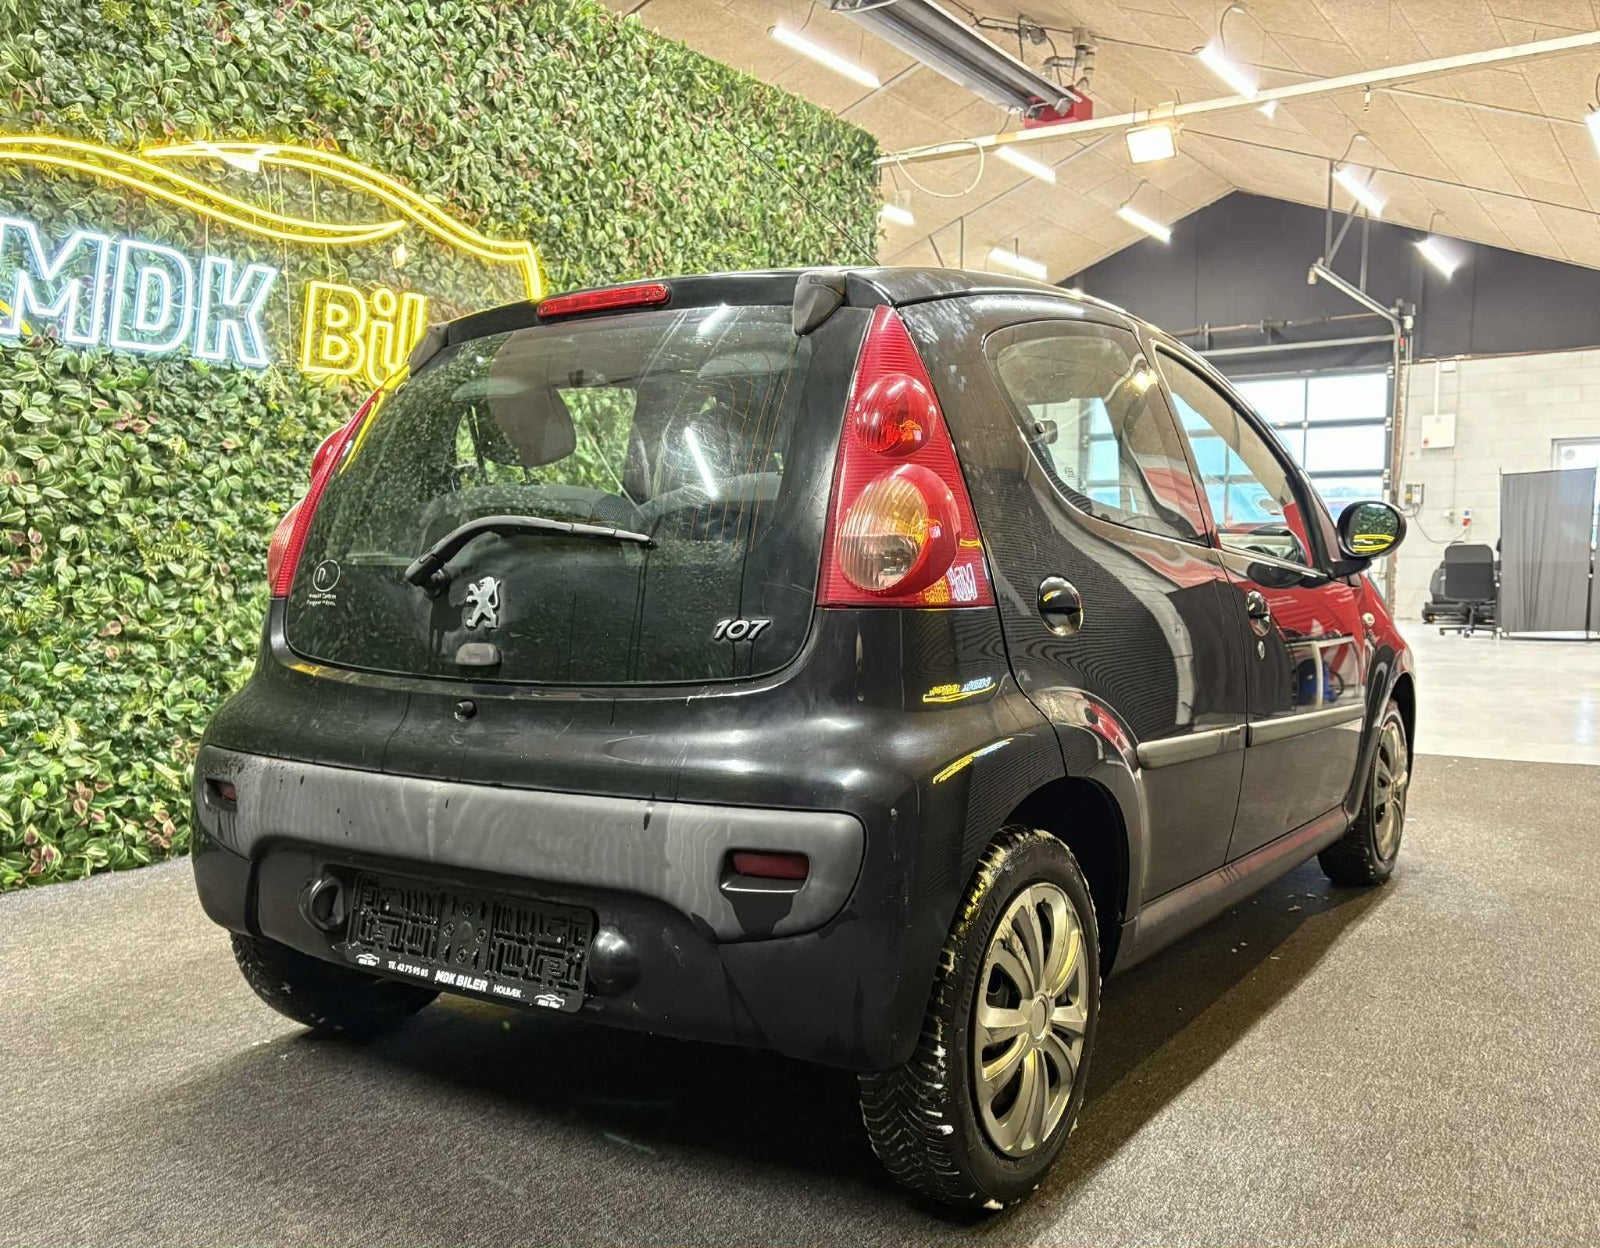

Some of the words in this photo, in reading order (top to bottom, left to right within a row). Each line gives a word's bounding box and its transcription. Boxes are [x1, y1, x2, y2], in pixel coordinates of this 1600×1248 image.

[0, 217, 277, 366] MDK
[713, 619, 770, 639] 107
[434, 970, 457, 987] MDK
[456, 974, 489, 992] BILER
